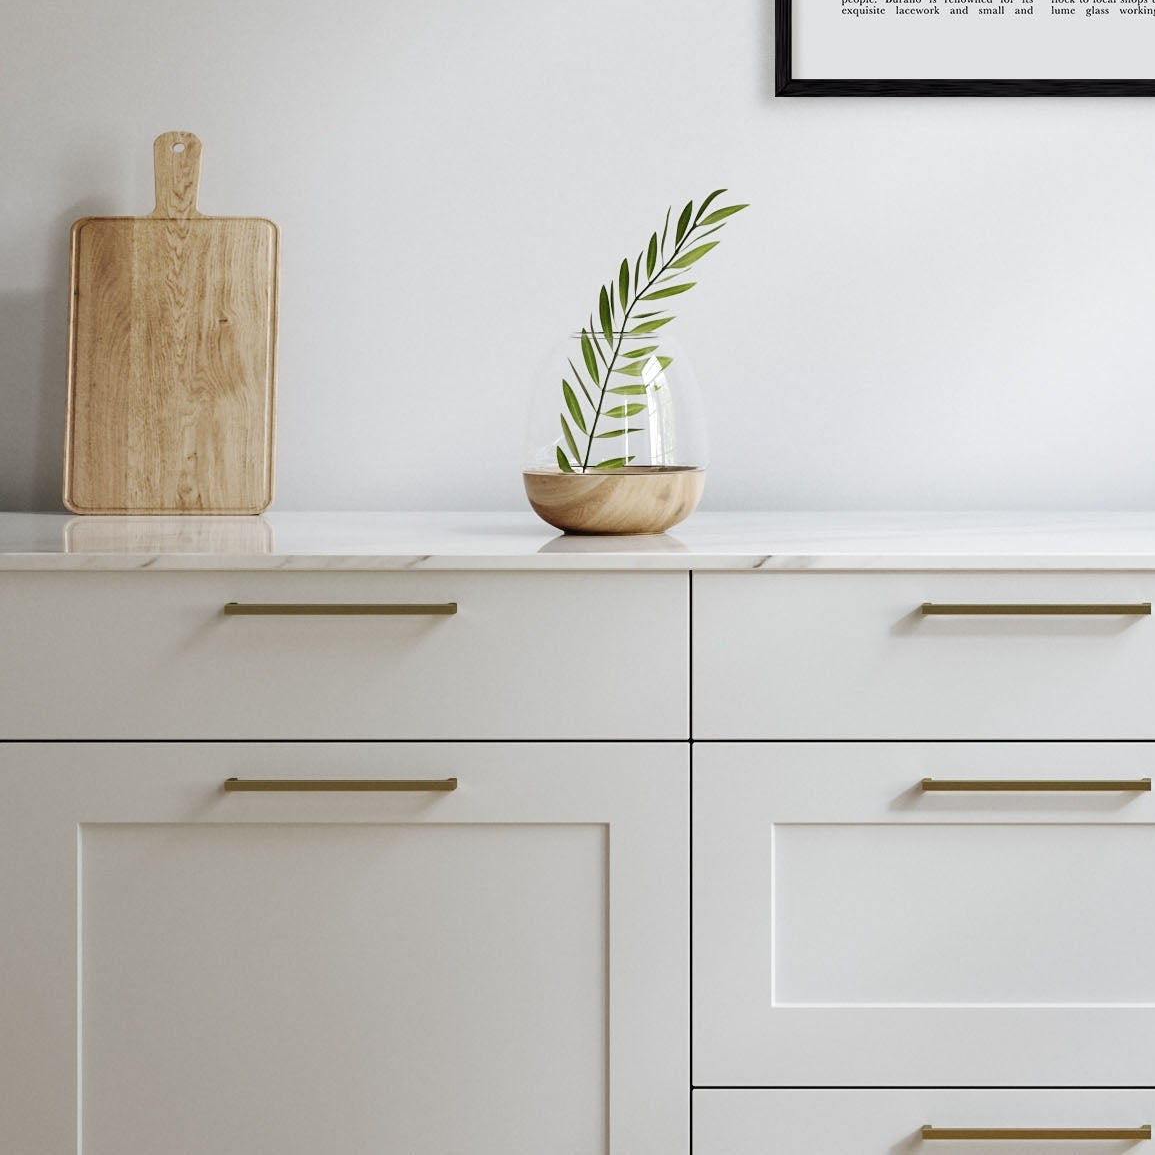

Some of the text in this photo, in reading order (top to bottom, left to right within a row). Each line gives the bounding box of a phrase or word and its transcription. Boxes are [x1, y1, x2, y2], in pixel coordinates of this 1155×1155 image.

[841, 6, 1034, 17] exquisite lacework and small and
[1051, 6, 1076, 15] lume
[1086, 6, 1110, 17] glass
